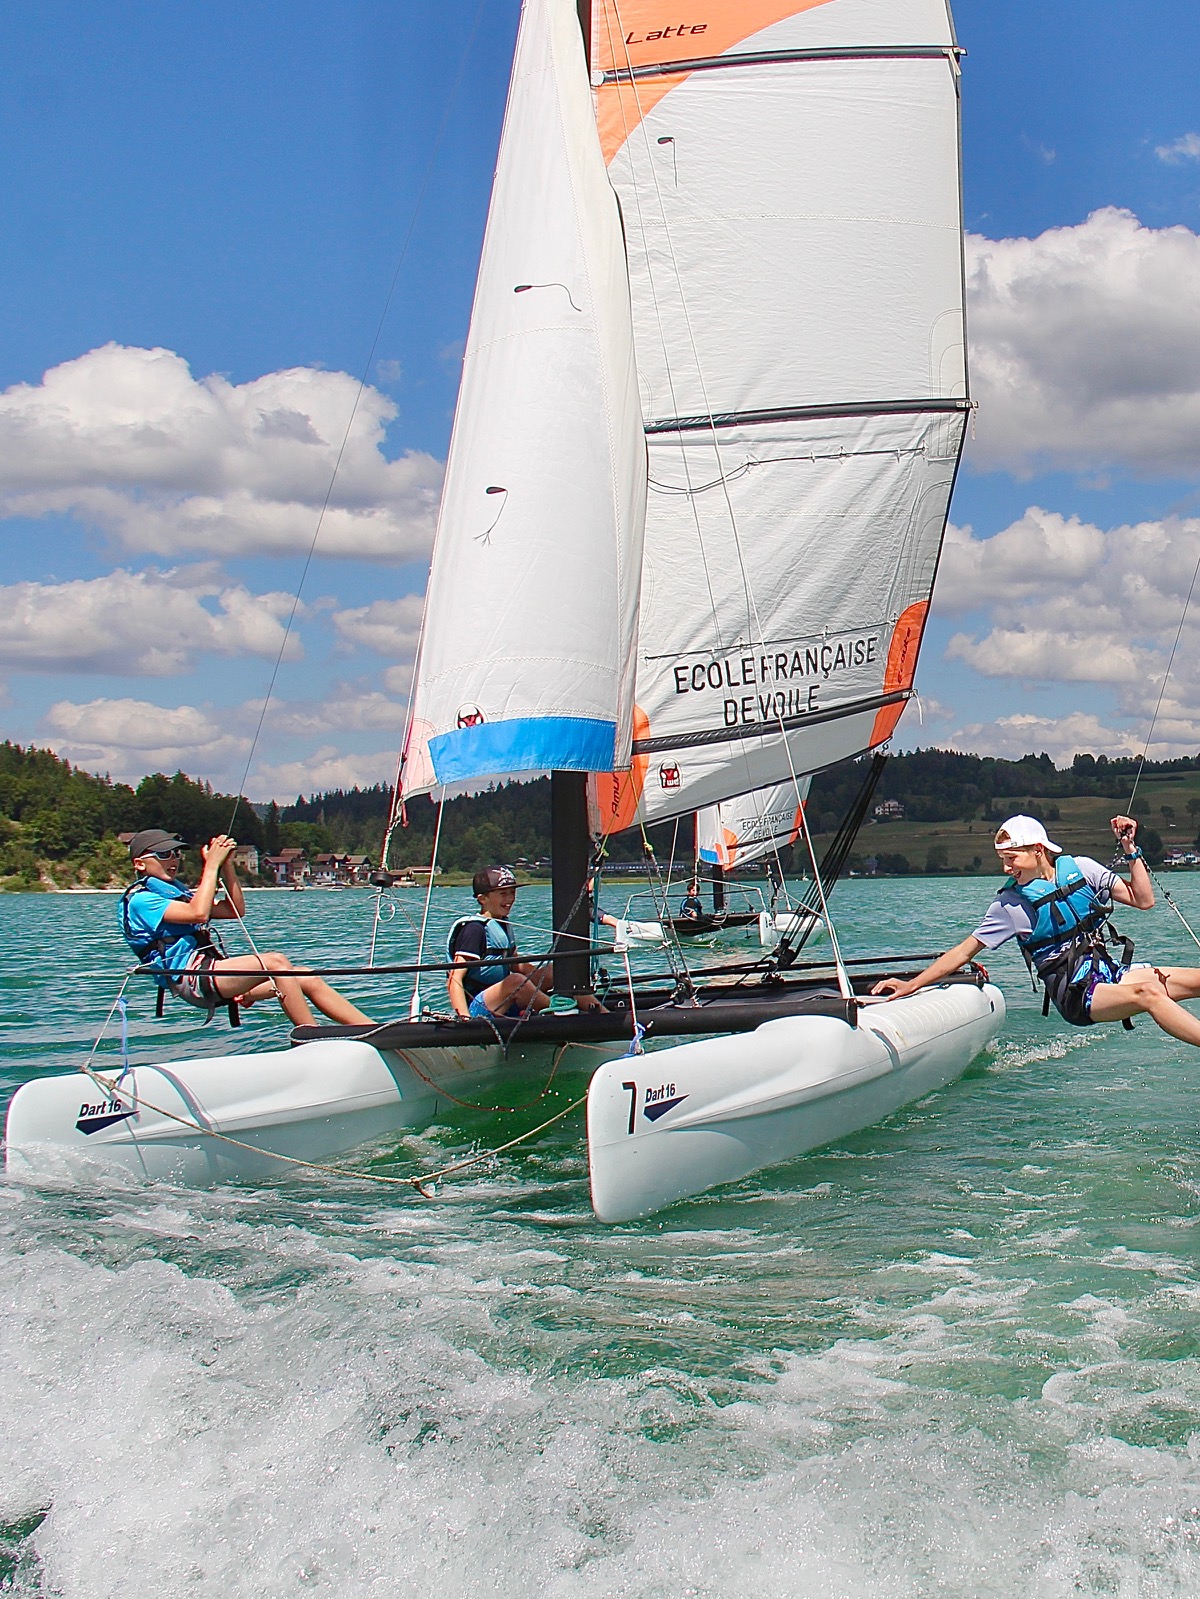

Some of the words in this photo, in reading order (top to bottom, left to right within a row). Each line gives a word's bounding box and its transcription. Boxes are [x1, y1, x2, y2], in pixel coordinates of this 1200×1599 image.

[625, 22, 708, 45] Latte
[673, 656, 757, 694] ECOLE
[760, 636, 878, 683] FRANÇAISE
[723, 695, 756, 726] DE
[757, 684, 821, 720] VOILE
[662, 777, 680, 787] fwd
[645, 1084, 664, 1103] Dart
[665, 1083, 676, 1098] 16
[79, 1101, 106, 1117] Dart
[108, 1099, 121, 1113] 16
[622, 1081, 637, 1135] 7
